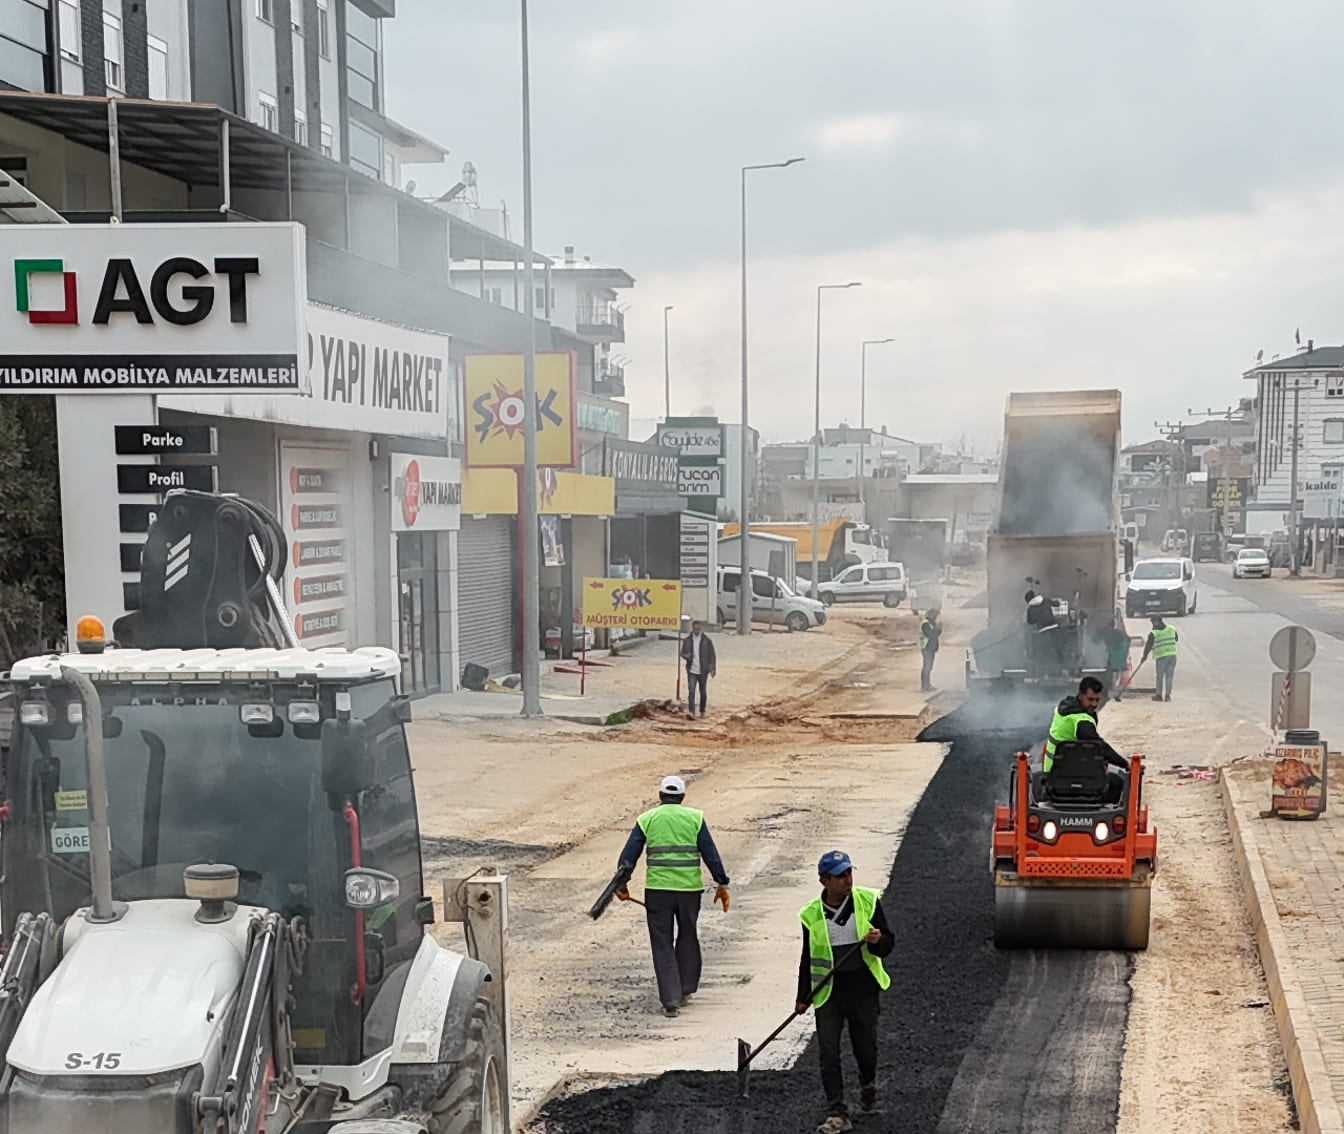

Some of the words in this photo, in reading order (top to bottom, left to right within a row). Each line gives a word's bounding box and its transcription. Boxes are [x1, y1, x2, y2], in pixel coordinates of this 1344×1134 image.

[92, 257, 260, 326] AGT
[82, 363, 170, 384] MOBİLYA
[175, 363, 297, 384] MALZEMLERİ
[320, 335, 366, 406] YAPI
[372, 346, 442, 414] MARKET
[472, 388, 563, 444] ŞOK
[142, 433, 184, 448] Parke
[148, 471, 185, 488] Profil
[611, 587, 653, 612] ŞOK
[586, 613, 627, 626] MÜŞTERİ
[1060, 818, 1093, 826] HAMM
[55, 833, 89, 848] GÖRE
[64, 1052, 122, 1070] S-15
